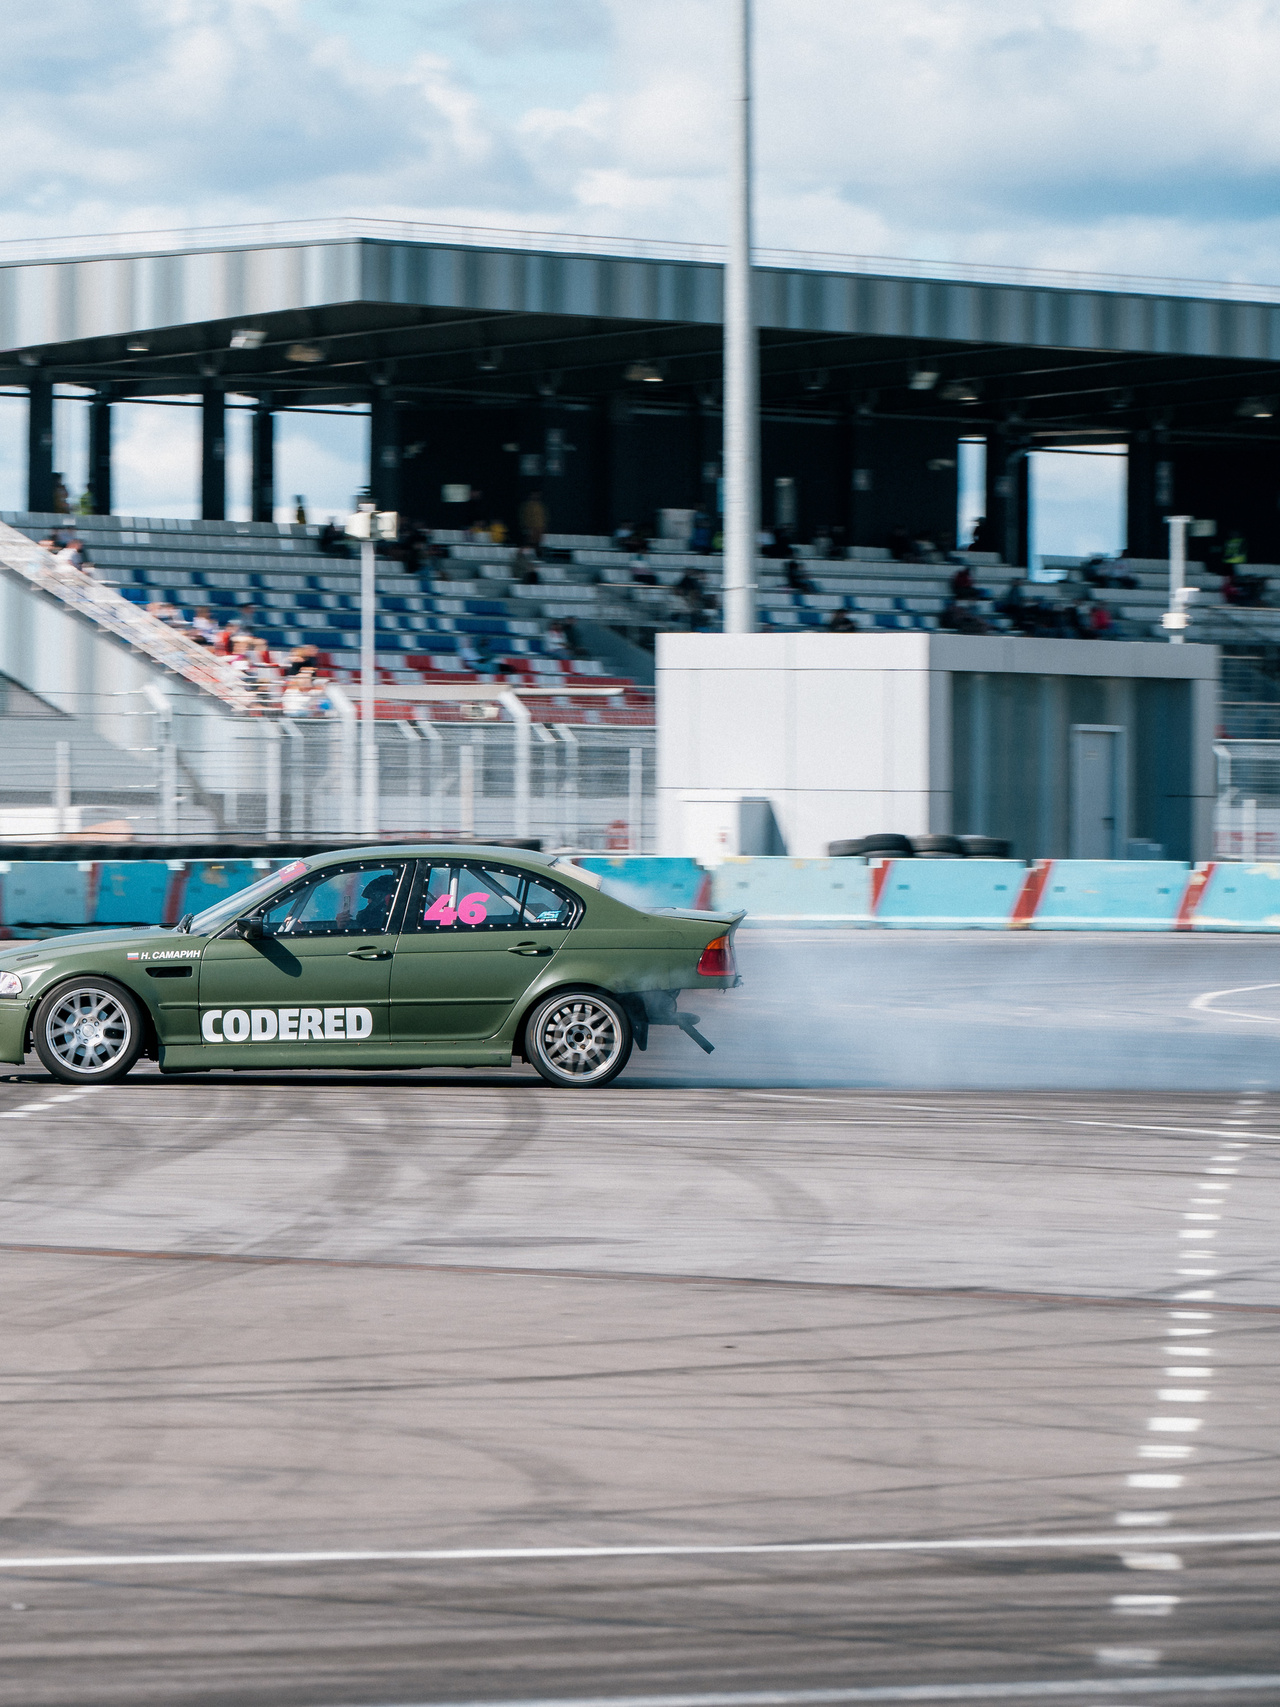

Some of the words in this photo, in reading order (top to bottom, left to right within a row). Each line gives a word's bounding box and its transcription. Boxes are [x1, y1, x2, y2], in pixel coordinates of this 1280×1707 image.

[424, 892, 490, 925] 46
[140, 951, 151, 960] Н.
[152, 950, 201, 960] САМАРИН
[201, 1007, 373, 1043] CODERED
